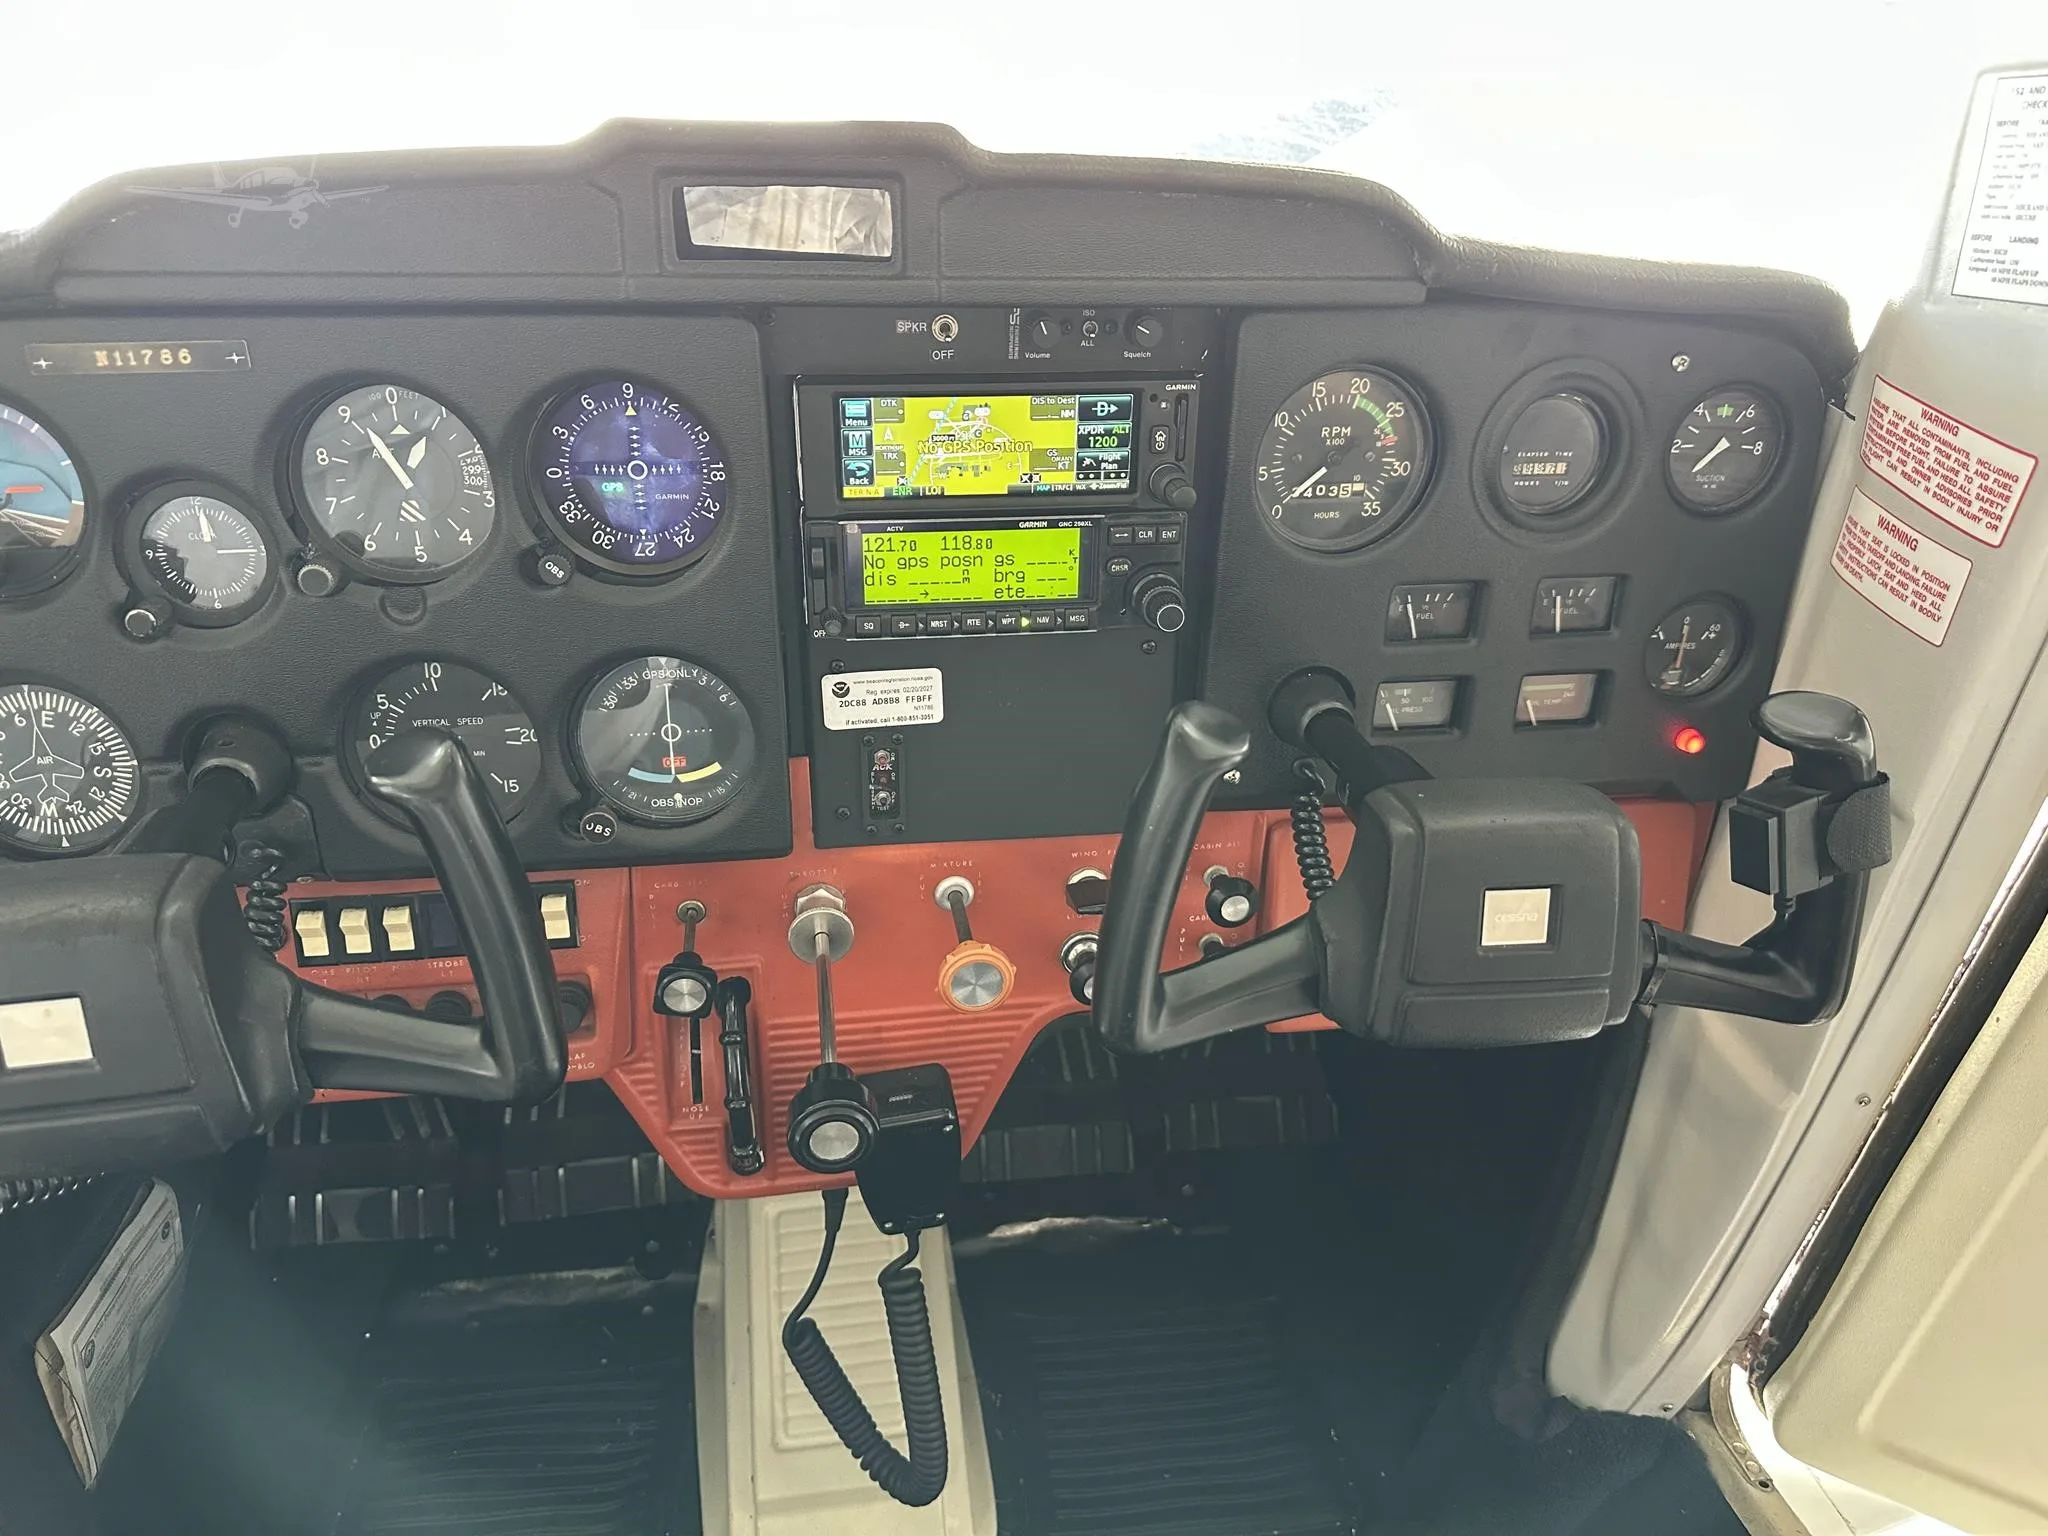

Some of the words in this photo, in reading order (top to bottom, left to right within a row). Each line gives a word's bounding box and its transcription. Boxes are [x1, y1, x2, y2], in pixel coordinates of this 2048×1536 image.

[897, 321, 927, 332] SPKR
[95, 348, 192, 368] N11786
[932, 350, 955, 360] OFF
[1123, 351, 1151, 359] Squelch
[1312, 382, 1326, 397] 15
[1350, 378, 1370, 393] 20
[386, 387, 398, 404] 0
[399, 390, 420, 400] FEET
[581, 394, 596, 410] 6
[880, 399, 898, 407] DTK
[1386, 402, 1405, 418] 25
[1693, 402, 1704, 416] 4
[338, 405, 351, 423] 9
[1746, 403, 1756, 418] 6
[845, 419, 868, 427] Menu
[1274, 411, 1289, 427] 10
[1921, 407, 1960, 437] WARNING
[552, 425, 569, 440] 3
[1078, 425, 1105, 435] XPDR
[1112, 425, 1130, 434] ALT
[1321, 426, 1351, 437] RPM
[917, 441, 938, 454] No
[942, 441, 972, 453] GPS
[976, 441, 1033, 452] Position
[1088, 436, 1118, 448] 1200
[1325, 438, 1345, 446] X100
[1671, 439, 1682, 453] 2
[1753, 442, 1763, 455] 8
[316, 448, 329, 466] 8
[849, 448, 868, 456] MSG
[1046, 449, 1058, 457] GS
[1908, 420, 1920, 432] ALL
[1975, 457, 2020, 483] INCLUDING
[1058, 462, 1069, 470] KT
[1902, 427, 1931, 448] REMOVED
[1933, 445, 1952, 460] FROM
[1953, 457, 1971, 472] FUEL
[1973, 468, 1990, 481] AND
[1992, 478, 2014, 493] FUEL
[546, 467, 562, 479] 0
[709, 461, 726, 482] 18
[1258, 466, 1269, 481] 5
[1391, 461, 1411, 477] 30
[849, 477, 869, 485] Back
[1695, 474, 1726, 482] SUCTION
[1911, 454, 1926, 469] FUEL
[1926, 465, 1940, 477] AND
[1940, 472, 1958, 488] HEED
[1958, 484, 1972, 496] ALL
[1974, 492, 2007, 513] SAFETY
[1933, 457, 1961, 477] FAILURE
[1963, 474, 1974, 485] TO
[1977, 483, 2012, 504] ASSURE
[602, 482, 624, 492] GPS
[892, 487, 913, 496] ENR
[483, 490, 495, 507] 3
[1900, 470, 1922, 487] RESULT
[1932, 490, 1956, 509] BODILY
[1956, 505, 1983, 525] INJURY
[1985, 521, 1999, 532] OR
[1911, 466, 1932, 483] OWNER
[1935, 482, 1973, 508] ADVISORIES
[1977, 506, 2003, 523] PRIOR
[326, 497, 337, 515] 7
[559, 500, 582, 523] 33
[701, 499, 720, 520] 21
[1271, 504, 1283, 519] 0
[1361, 502, 1381, 517] 35
[1314, 511, 1340, 519] HOURS
[459, 528, 473, 545] 4
[592, 530, 615, 549] 30
[673, 526, 695, 548] 24
[1877, 514, 1919, 552] WARNING
[364, 538, 376, 551] 6
[634, 542, 656, 557] 27
[864, 537, 917, 552] 121.70
[941, 535, 993, 551] 118.80
[145, 549, 153, 559] 9
[415, 546, 427, 563] 5
[864, 556, 886, 570] No
[898, 556, 929, 570] gps
[940, 555, 983, 569] posn
[994, 554, 1016, 568] gs
[545, 562, 565, 579] OBS
[994, 571, 1026, 583] brg
[1889, 548, 1911, 568] LOCKED
[1921, 569, 1951, 592] POSITION
[865, 573, 897, 586] dis
[994, 586, 1025, 599] ete
[1920, 582, 1947, 602] FAILURE
[214, 599, 222, 609] 6
[1415, 612, 1435, 620] FUEL
[1683, 616, 1690, 624] 0
[1918, 604, 1942, 623] BODILY
[864, 622, 874, 630] SQ
[930, 620, 947, 628] NRST
[1001, 617, 1016, 625] WPT
[1709, 623, 1721, 632] 60
[424, 662, 441, 678] 10
[642, 669, 665, 680] GPS
[669, 669, 699, 679] ONLY
[621, 677, 638, 690] 33
[376, 694, 389, 709] 5
[839, 699, 867, 708] 2DC88
[872, 697, 900, 705] AD8B8
[905, 695, 932, 703] FFBFF
[370, 712, 382, 720] UP
[1401, 705, 1424, 713] PRESS
[14, 713, 27, 727] 6
[41, 711, 55, 728] E
[411, 718, 451, 727] VERTICAL
[456, 717, 484, 725] SPEED
[68, 721, 86, 737] 12
[88, 741, 106, 756] 15
[369, 734, 381, 749] 0
[37, 756, 54, 765] AIR
[872, 763, 893, 771] ACK
[93, 765, 112, 778] S
[504, 779, 519, 793] 15
[88, 786, 106, 801] 21
[11, 793, 32, 810] 30
[65, 800, 87, 815] 24
[651, 798, 674, 807] OBS
[1193, 843, 1222, 851] CABIN
[1071, 850, 1098, 859] WING
[427, 959, 465, 969] STROBE
